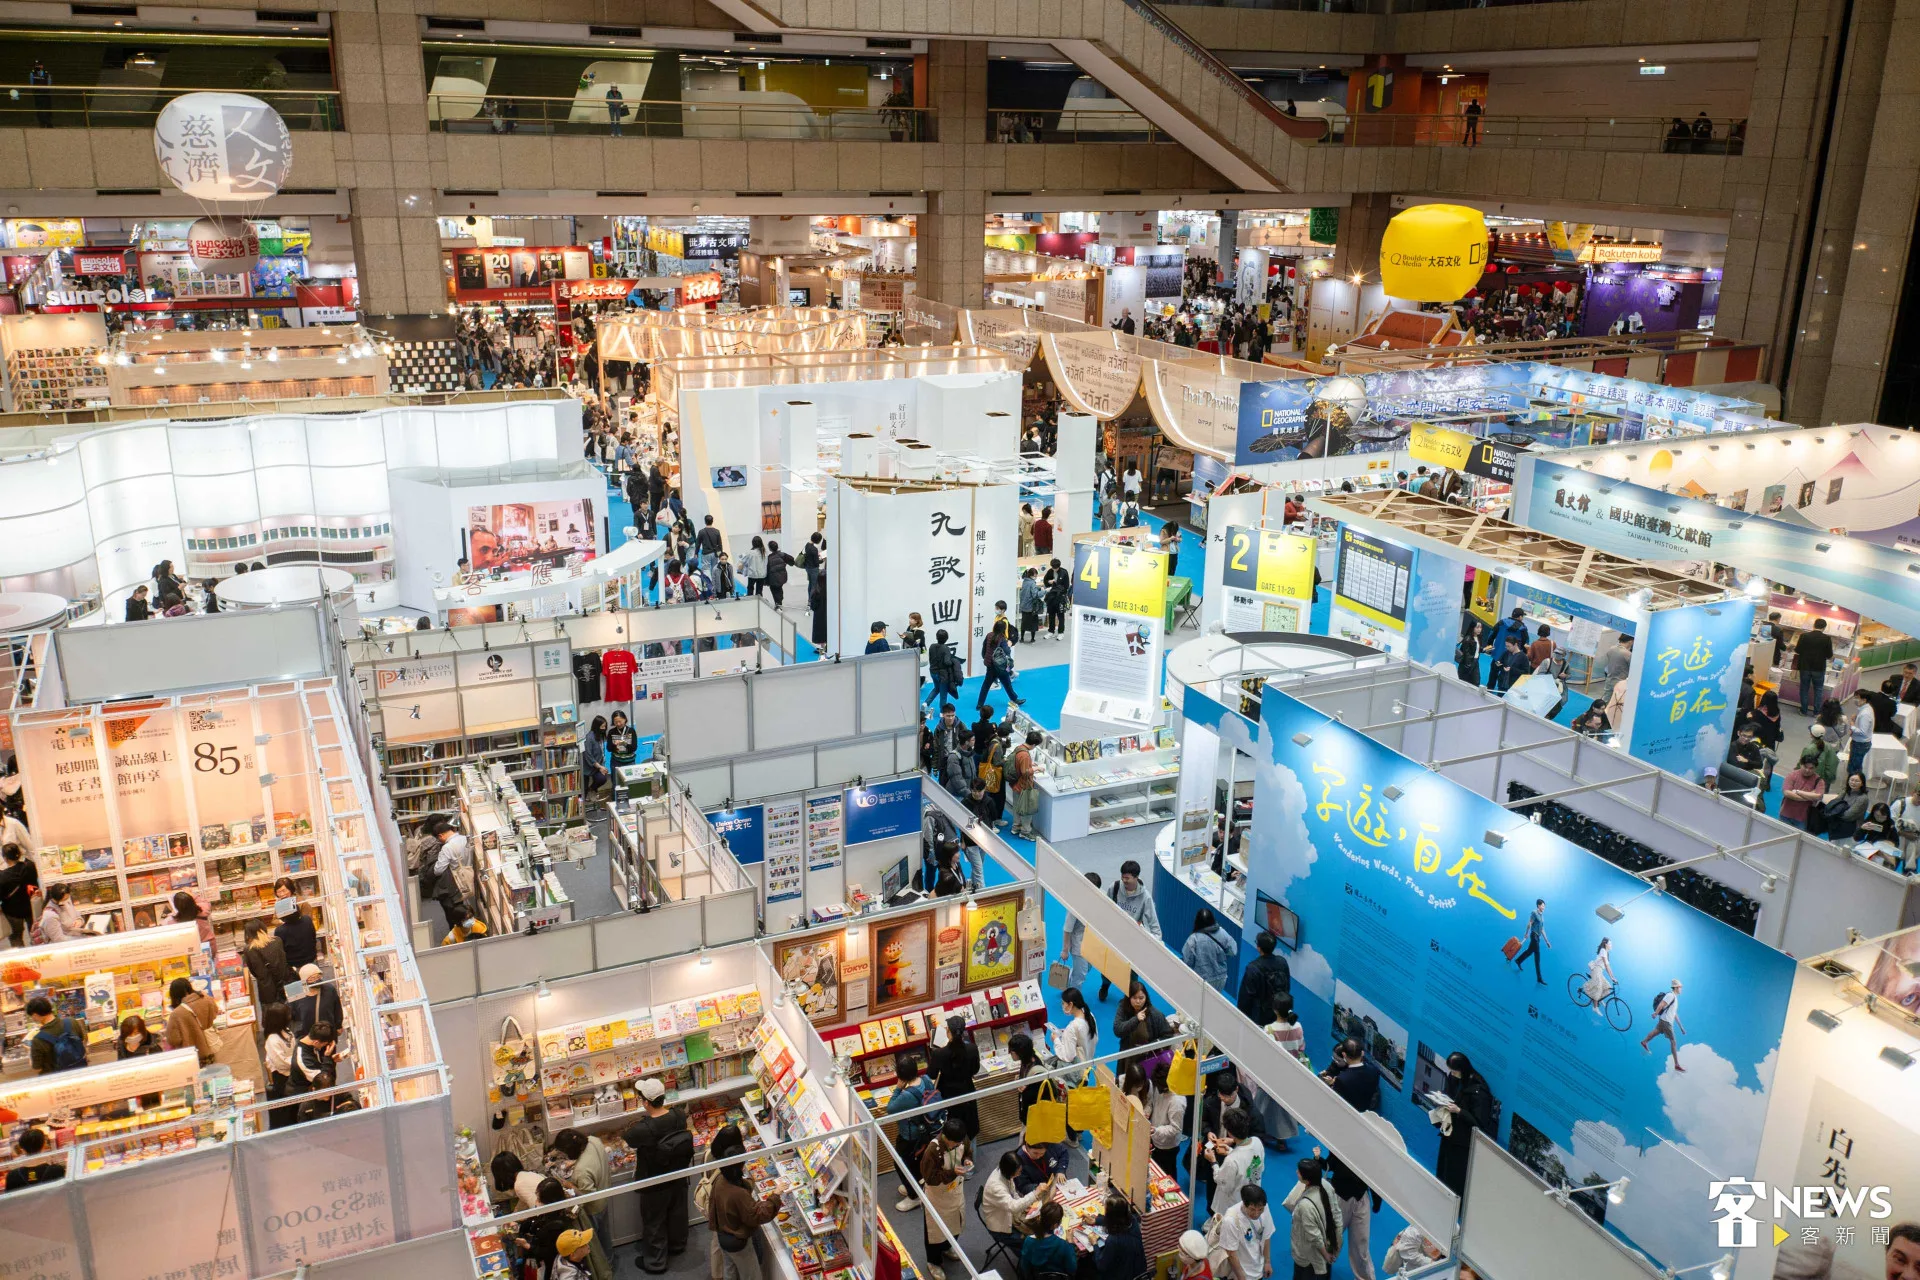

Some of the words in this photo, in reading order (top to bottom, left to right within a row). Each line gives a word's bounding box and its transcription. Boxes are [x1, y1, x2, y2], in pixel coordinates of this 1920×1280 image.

[1312, 226, 1337, 237] 文化
[688, 237, 737, 248] 世界古文明
[80, 256, 120, 265] suncolor
[492, 254, 510, 269] 20
[1402, 254, 1429, 262] Boulder
[1428, 256, 1461, 267] 大石文化
[1598, 249, 1637, 259] Rakuten
[1638, 250, 1662, 260] kobo
[1402, 260, 1422, 268] Media
[46, 284, 156, 306] suncolor
[1107, 354, 1129, 373] สวัสดี
[1203, 391, 1239, 415] Pavilio
[1586, 382, 1629, 401] 年度精選
[1633, 391, 1689, 414] 從書本開始
[1273, 407, 1303, 418] NATIONAL
[1273, 414, 1308, 425] GEOGRAPHIC
[1440, 443, 1462, 458] 大石文化
[1493, 448, 1516, 460] NATIONA
[1555, 488, 1592, 515] 國史館
[1609, 505, 1713, 549] 國史館臺灣文獻館
[1627, 531, 1651, 543] TAIWAN
[1654, 539, 1689, 554] HISTORICA
[1230, 533, 1251, 572] 2
[1080, 551, 1101, 590] 4
[1261, 581, 1276, 592] GATE
[1277, 584, 1296, 596] 11-20
[1112, 600, 1128, 611] GATE
[1129, 603, 1149, 614] 31-40
[1669, 687, 1727, 724] 自在
[55, 758, 99, 776] 展期間
[114, 750, 173, 768] 誠品線上
[194, 742, 241, 776] 85
[57, 777, 102, 794] 電子書
[117, 769, 161, 786] 館再享
[715, 819, 734, 829] Union
[1333, 832, 1371, 870] Wandering
[1373, 858, 1402, 882] Words,
[1405, 875, 1425, 897] Free
[1427, 893, 1457, 910] Spirits
[842, 962, 869, 975] TOKYO
